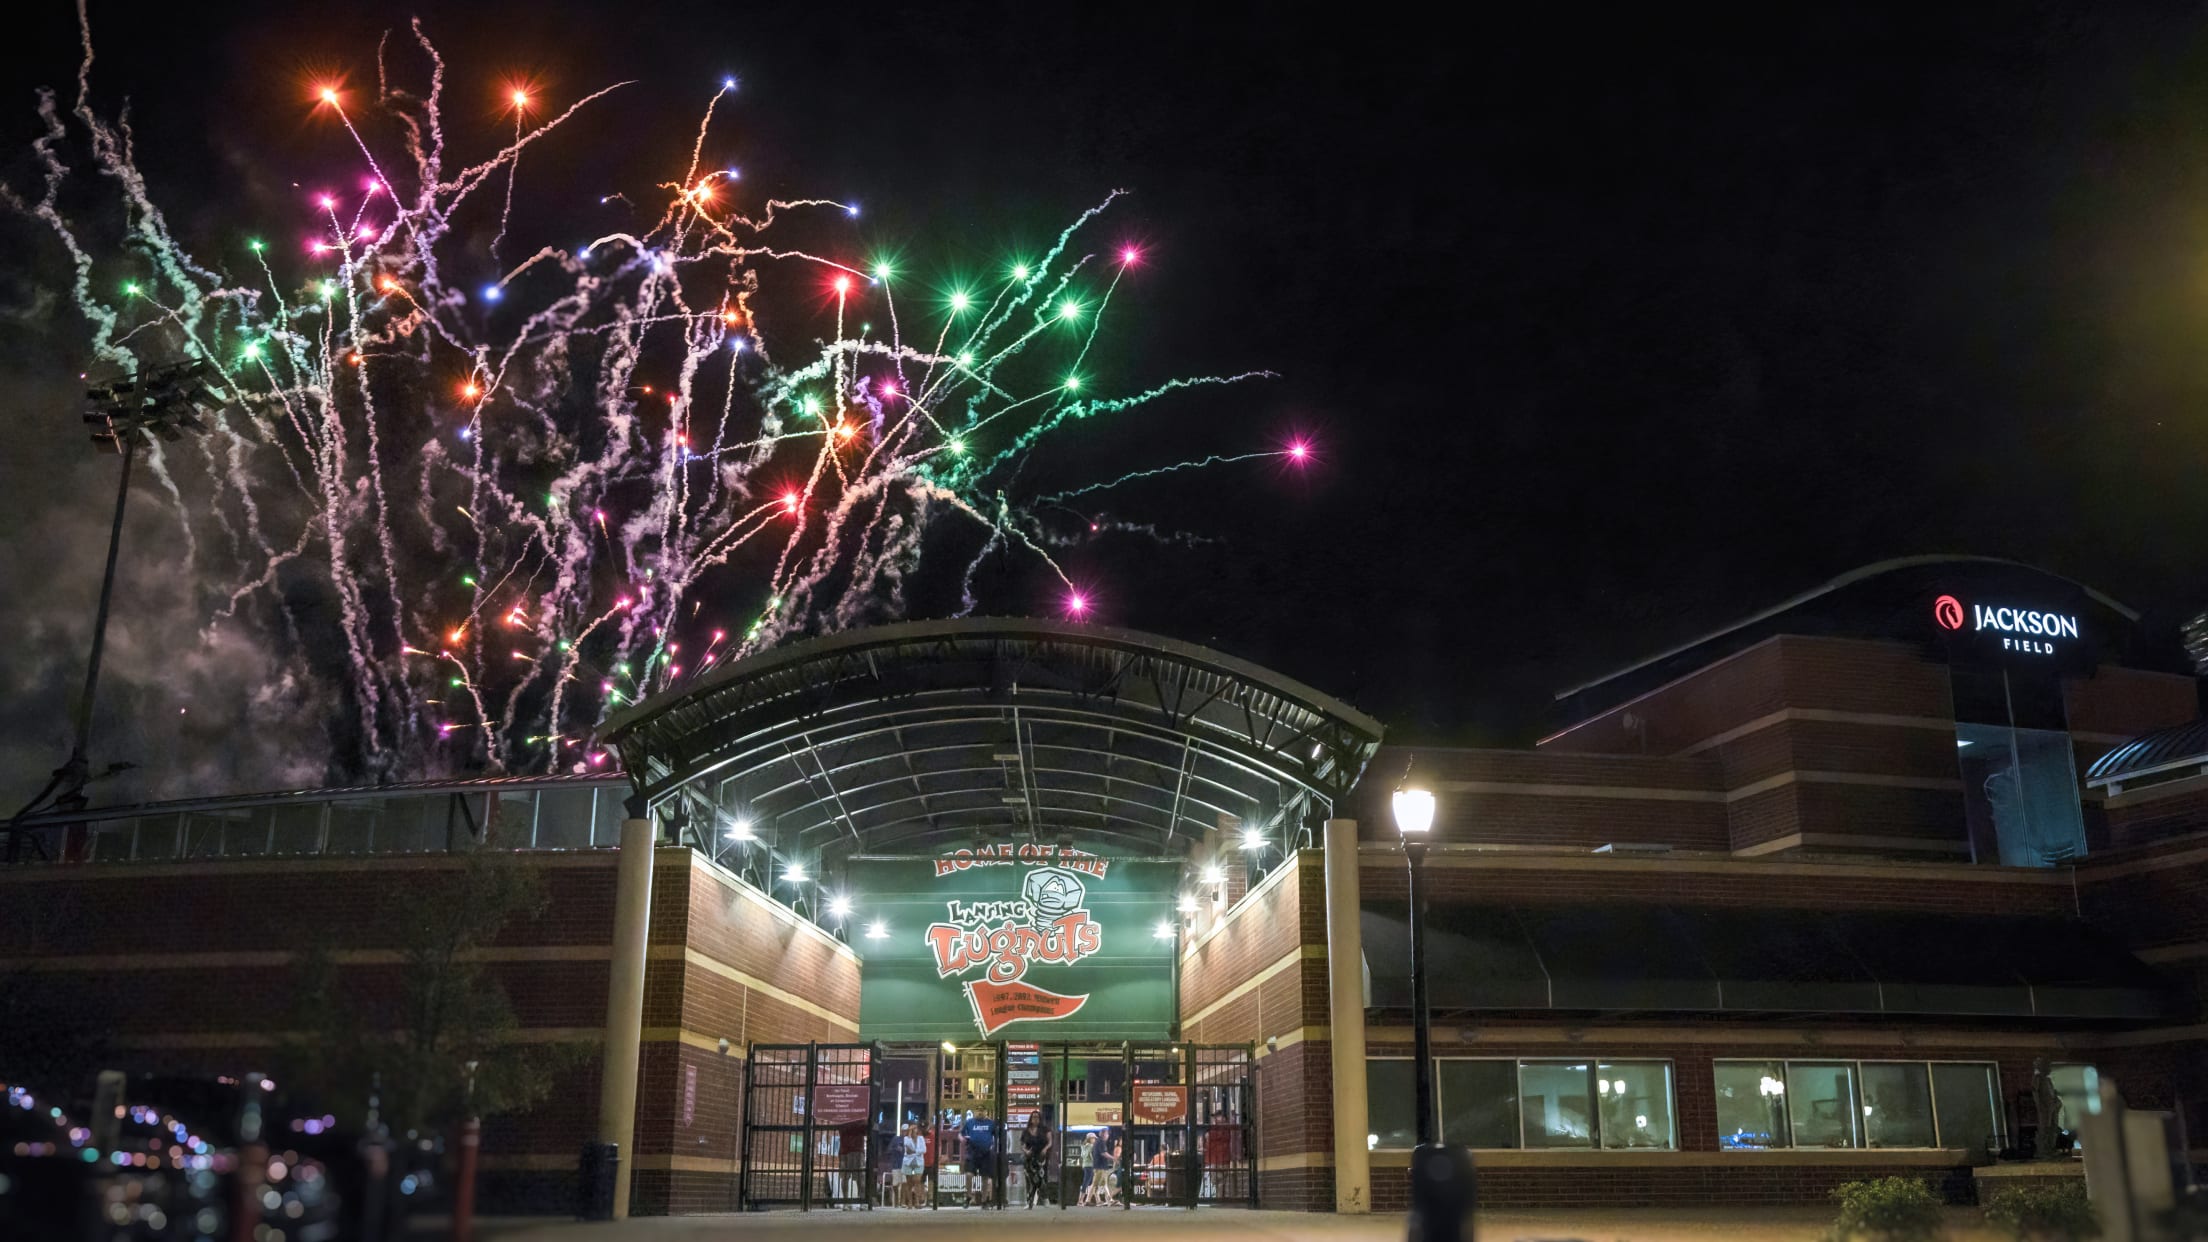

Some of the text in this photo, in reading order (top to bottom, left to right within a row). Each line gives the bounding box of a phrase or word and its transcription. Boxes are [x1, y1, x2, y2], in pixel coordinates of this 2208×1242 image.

[1974, 604, 2078, 638] JACKSON
[2003, 638, 2053, 654] FIELD
[935, 843, 1109, 880] HOME OF THE
[947, 900, 1028, 925] LANSING
